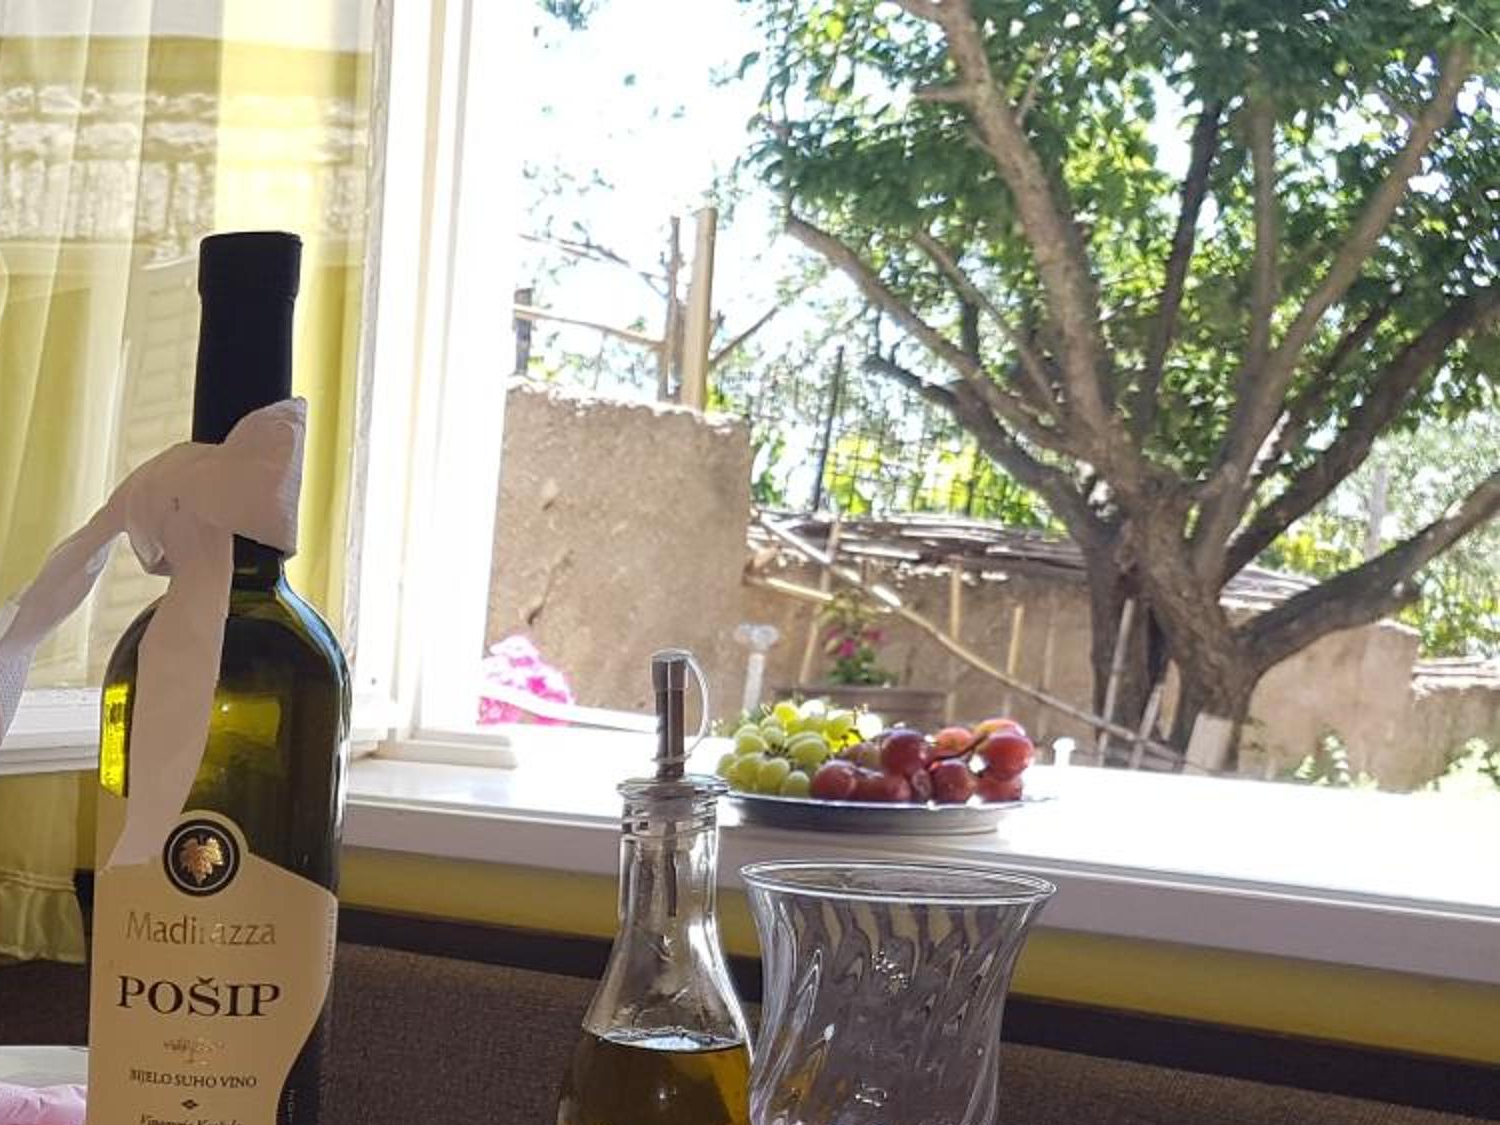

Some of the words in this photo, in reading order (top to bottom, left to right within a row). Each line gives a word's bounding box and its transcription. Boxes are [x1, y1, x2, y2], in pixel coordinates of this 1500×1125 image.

[116, 975, 280, 1017] POŠIP
[129, 1069, 172, 1085] BIJELO
[174, 1073, 217, 1088] SUHO
[219, 1074, 257, 1089] VINO
